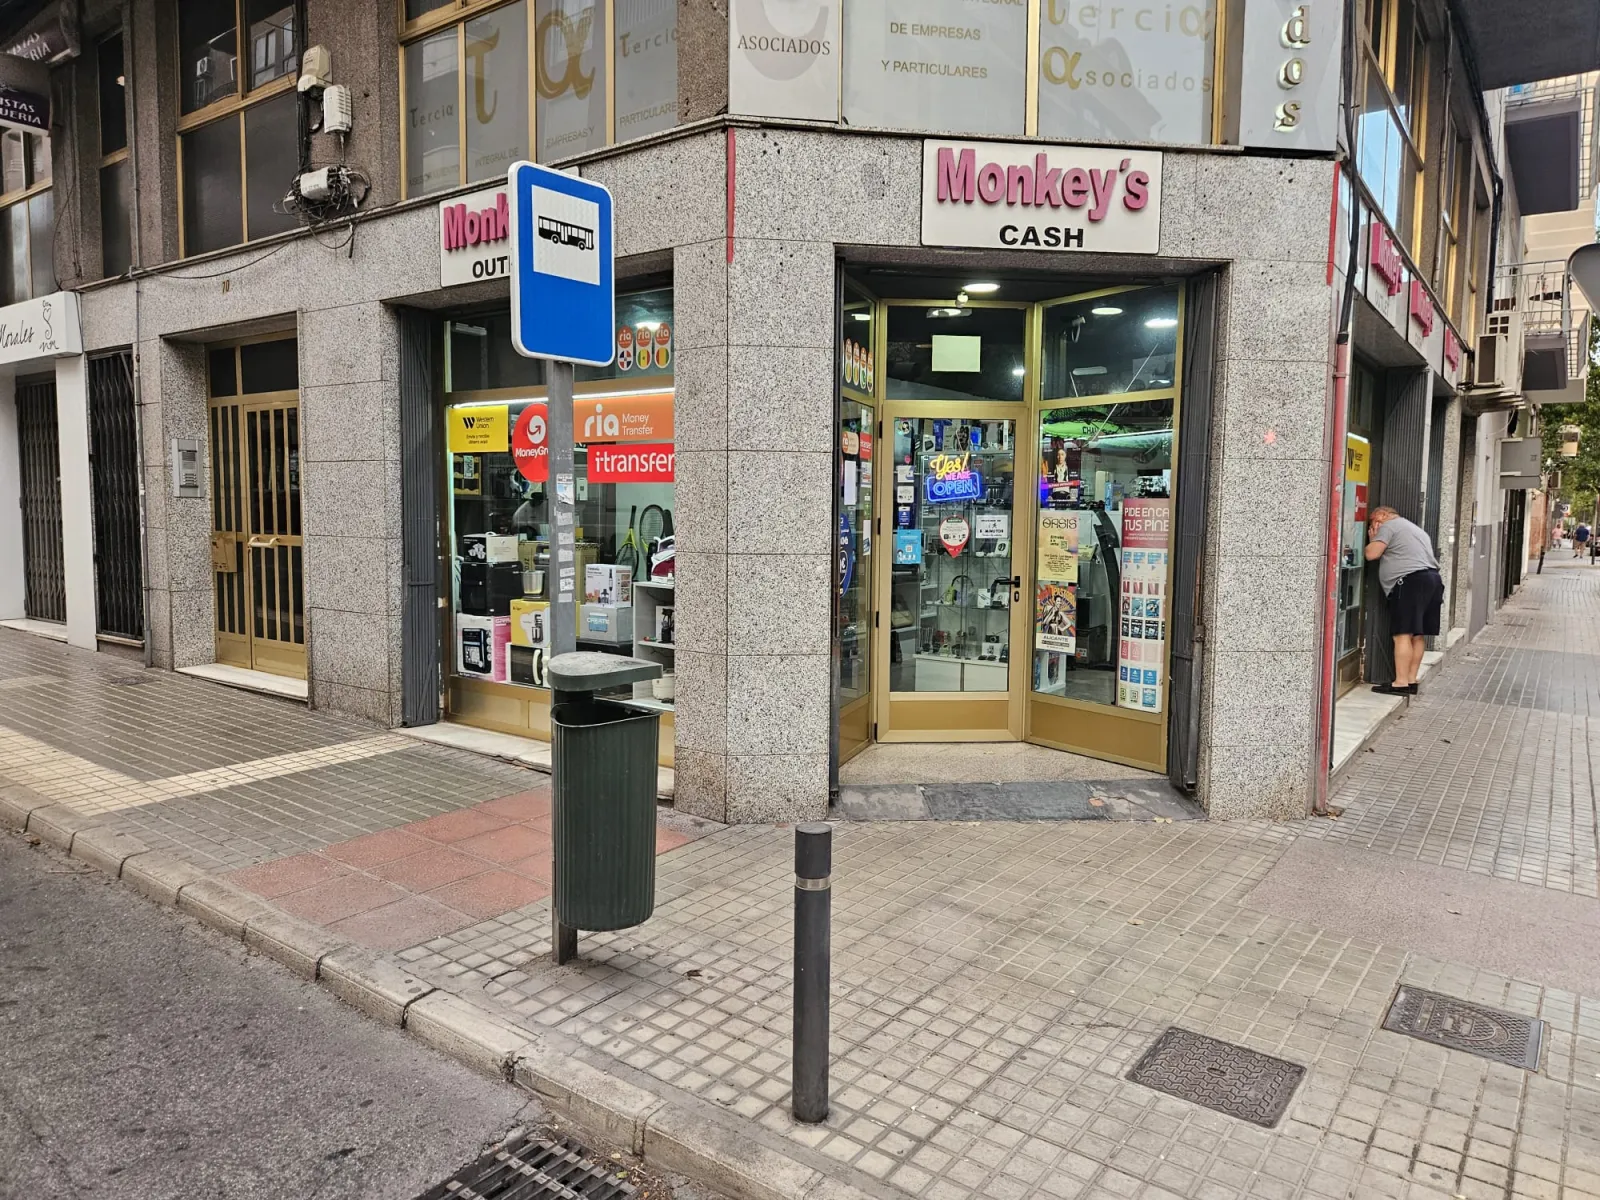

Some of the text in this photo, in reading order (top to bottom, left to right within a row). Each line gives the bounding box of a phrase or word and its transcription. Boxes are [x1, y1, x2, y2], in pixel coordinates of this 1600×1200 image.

[890, 22, 981, 40] DE EMPRESAS
[737, 35, 831, 56] ASOCIADOS
[881, 60, 988, 79] Y PARTICULARES
[937, 147, 1150, 222] Monkey's
[999, 225, 1084, 248] CASH
[472, 256, 511, 279] OUT
[584, 403, 620, 437] ria
[622, 413, 649, 425] Money
[622, 426, 653, 436] Transfer
[933, 480, 973, 496] OPEN
[1124, 507, 1141, 517] PIDE
[1042, 517, 1077, 530] OASIS
[1124, 519, 1142, 532] TUS
